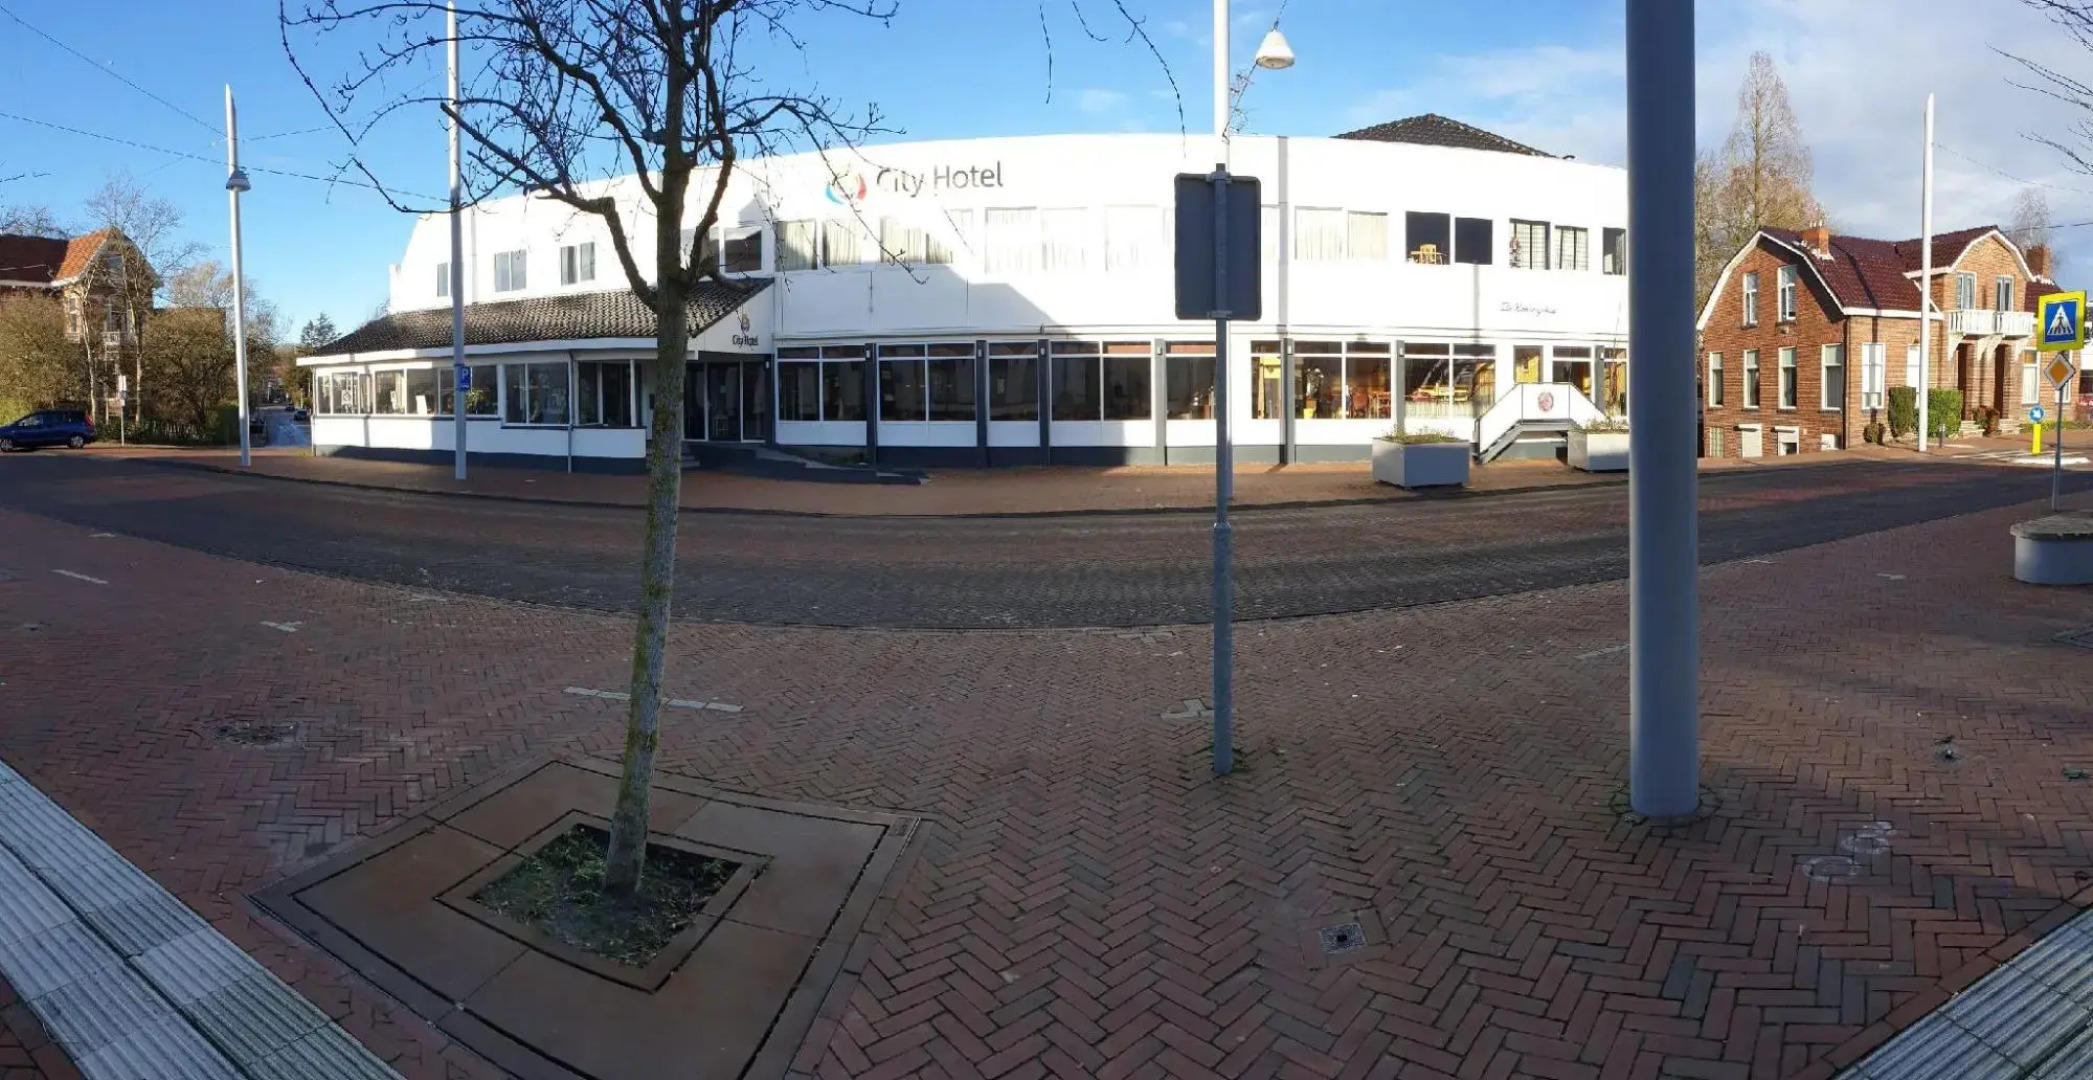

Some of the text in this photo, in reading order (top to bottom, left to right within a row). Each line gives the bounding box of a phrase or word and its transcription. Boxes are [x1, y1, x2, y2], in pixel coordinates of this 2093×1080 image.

[876, 159, 1004, 198] City Hotel
[461, 367, 470, 381] P
